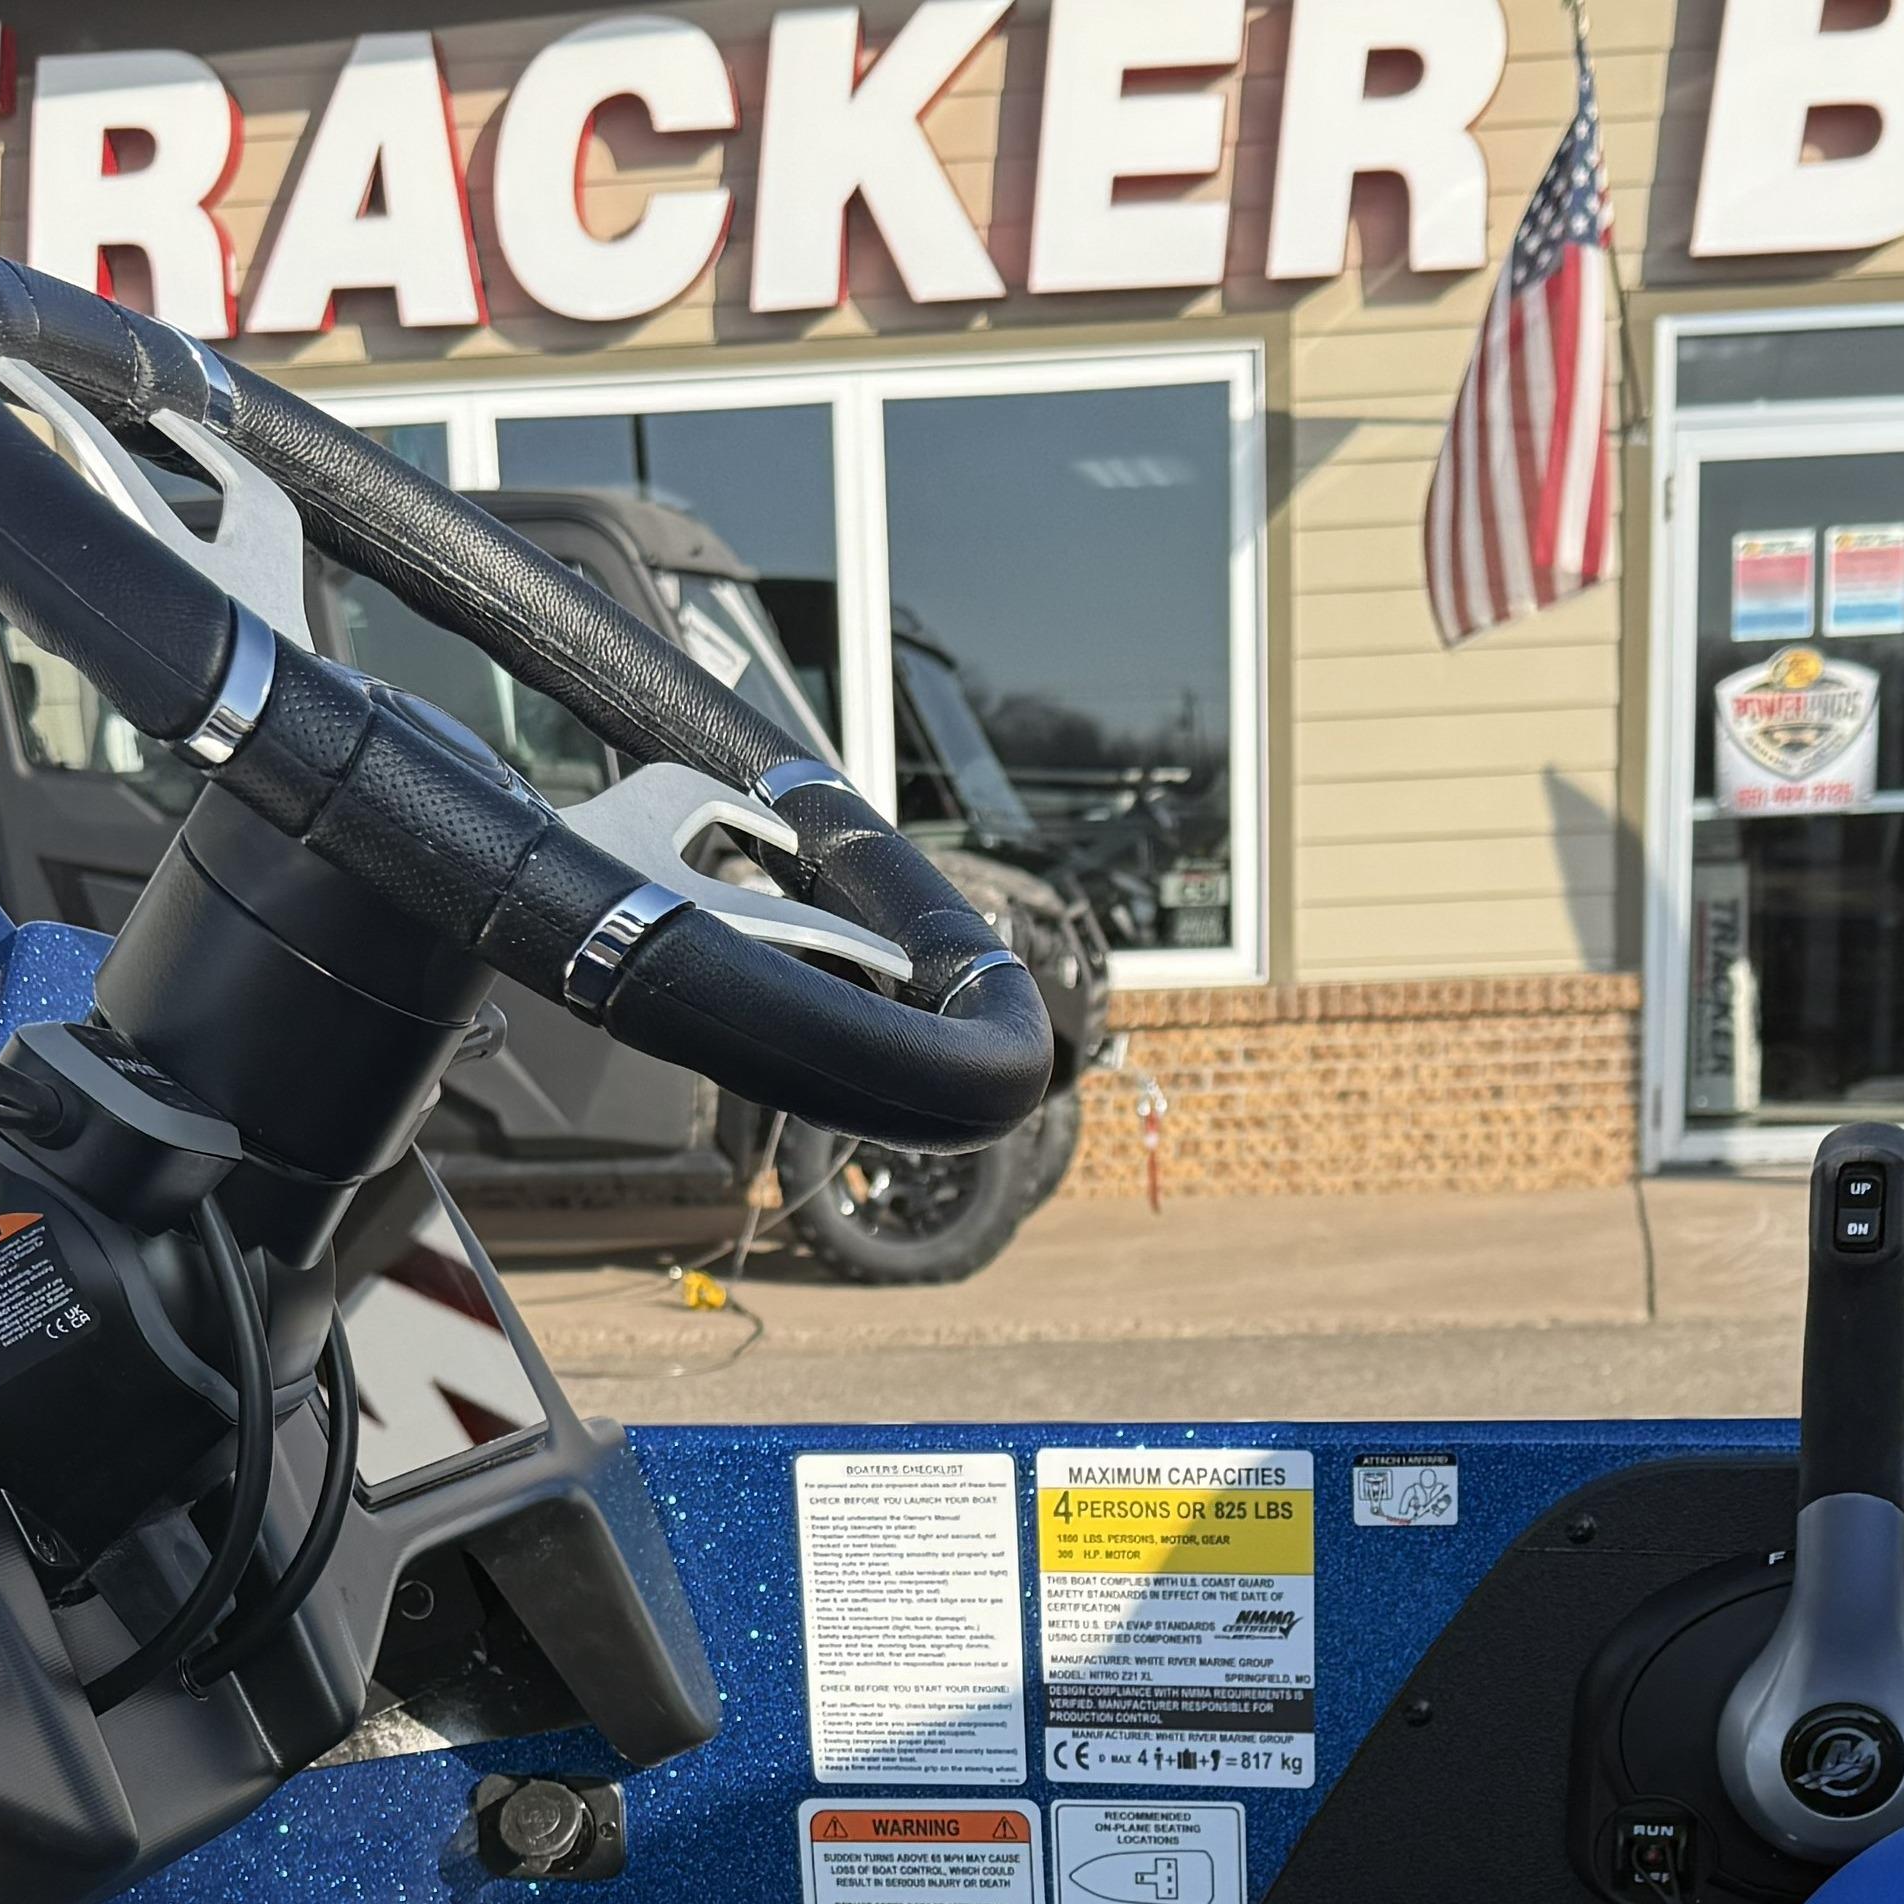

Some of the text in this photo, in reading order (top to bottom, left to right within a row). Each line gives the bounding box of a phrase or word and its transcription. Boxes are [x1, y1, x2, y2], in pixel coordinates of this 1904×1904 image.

[1850, 1182, 1872, 1195] UP
[63, 1303, 84, 1321] UK
[70, 1310, 92, 1329] CA
[46, 1317, 70, 1339] CE
[1068, 1467, 1286, 1485] MAXIMUM CAPACITIES
[1053, 1490, 1294, 1525] 4 PERSONS OR 825 LBS
[1768, 1550, 1787, 1565] F
[1047, 1576, 1067, 1586] THIS
[1070, 1576, 1096, 1586] BOAT
[1100, 1576, 1151, 1587] COMPLIES
[1152, 1577, 1178, 1587] WITH
[1201, 1578, 1235, 1588] COAST
[1238, 1578, 1274, 1588] GUARD
[1047, 1590, 1284, 1601] SAFETY STANDARDS IN EFFECT ON THE DATE OF
[1047, 1603, 1121, 1612] CERTIFICATION
[1048, 1620, 1080, 1630] MEETS
[1104, 1620, 1124, 1630] EPA
[1125, 1621, 1152, 1631] EVAP
[1154, 1621, 1216, 1631] STANDARDS
[1048, 1633, 1202, 1644] USING CERTIFIED COMPONENTS
[1134, 1656, 1164, 1666] WHITE
[1167, 1657, 1196, 1666] RIVER
[1198, 1657, 1235, 1667] MARINE
[1238, 1658, 1274, 1668] GROUP
[1089, 1671, 1119, 1681] NITRO
[1121, 1671, 1137, 1681] Z21
[1140, 1671, 1153, 1681] XL
[1294, 1675, 1311, 1684] MO
[1048, 1686, 1304, 1700] DESIGN COMPLIANCE WITH NMMA REQUIREMENTS IS
[1097, 1700, 1179, 1711] MANUFACTURER
[1181, 1701, 1250, 1712] RESPONSIBLE
[1252, 1702, 1274, 1712] FOR
[1049, 1712, 1162, 1724] PRODUCTION CONTROL
[1053, 1740, 1090, 1770] CE
[1111, 1754, 1132, 1764] MAX
[1137, 1749, 1148, 1765] 4
[1241, 1752, 1273, 1769] 817
[1280, 1752, 1303, 1774] kg
[1104, 1811, 1191, 1821] RECOMMENDED
[872, 1818, 960, 1837] WARNING
[1095, 1823, 1201, 1833] ON-PLANE SEATING
[1633, 1824, 1674, 1837] RUN
[1117, 1836, 1180, 1845] LOCATIONS
[823, 1854, 861, 1862] SUDDEN
[864, 1854, 894, 1862] TURNS
[897, 1854, 928, 1862] ABOVE
[943, 1854, 964, 1862] MPH
[988, 1855, 1020, 1863] CAUSE
[830, 1866, 855, 1875] LOSS
[857, 1866, 868, 1875] OF
[871, 1866, 896, 1875] BOAT
[949, 1867, 980, 1875] WHICH
[981, 1867, 1015, 1876] COULD
[836, 1878, 1011, 1888] RESULT IN SERIOUS INJURY OR DEATH
